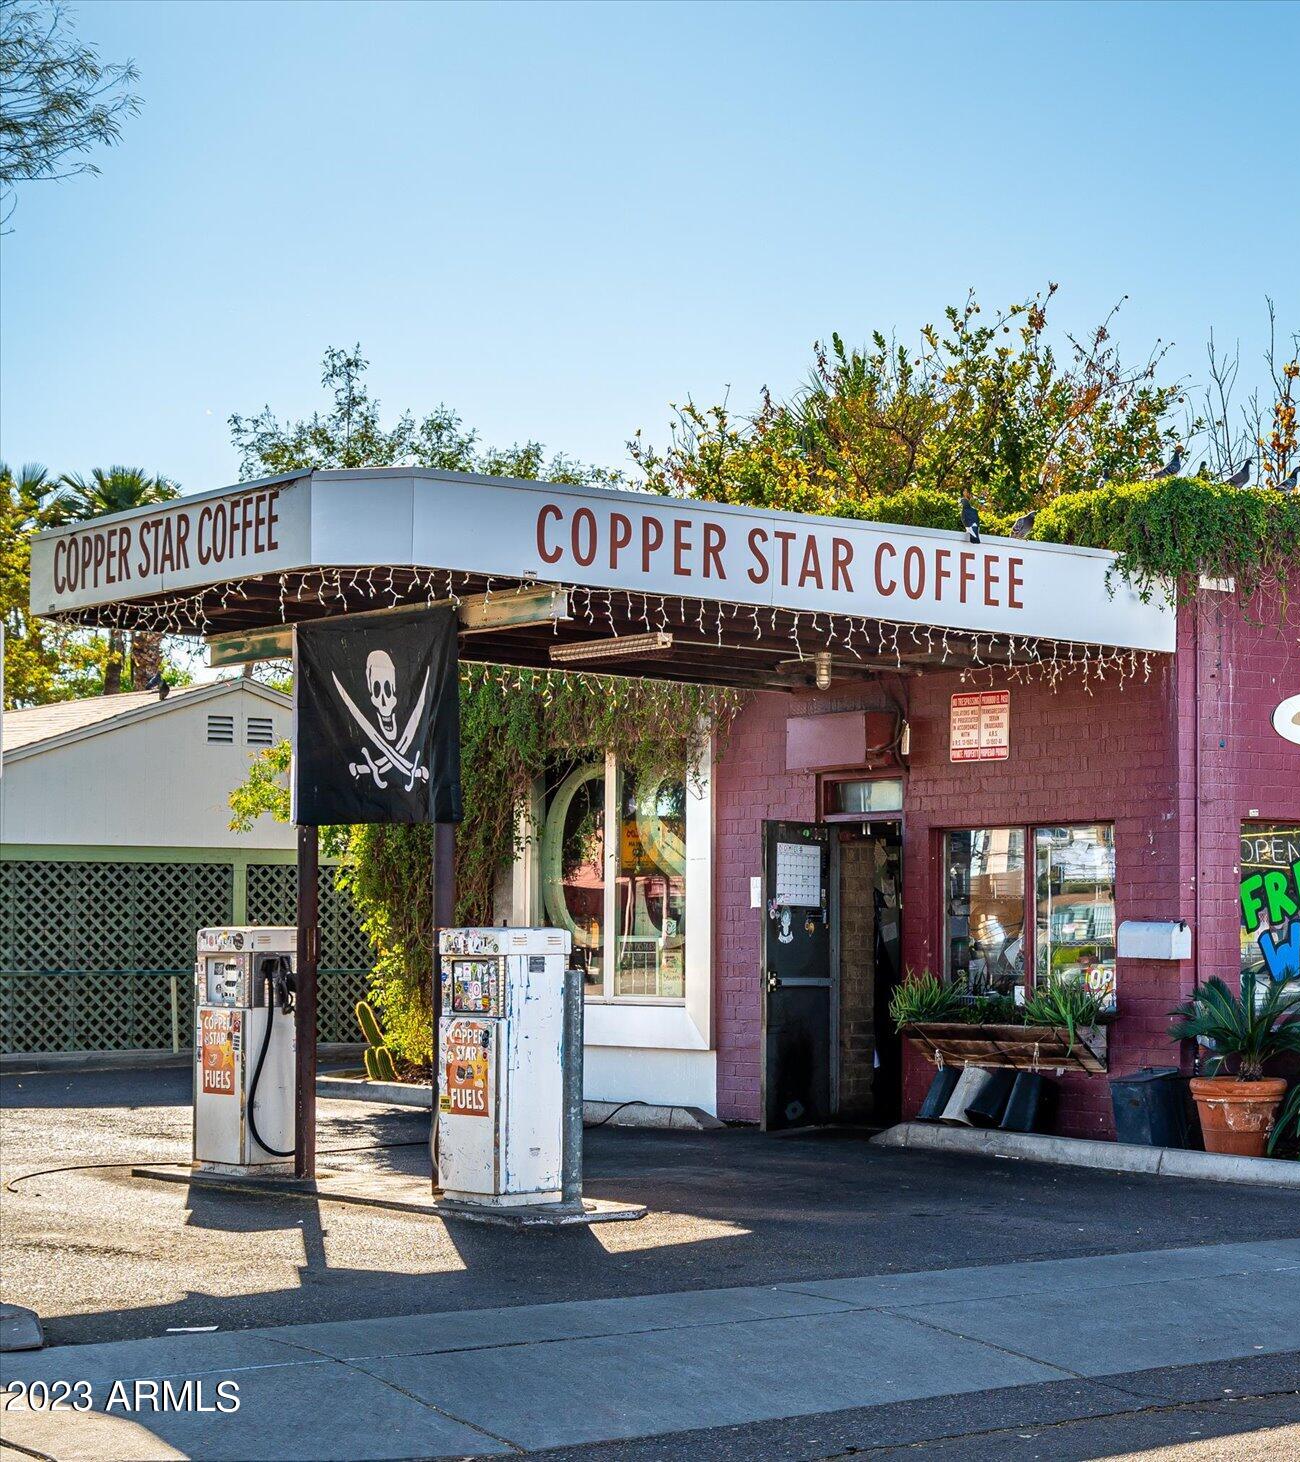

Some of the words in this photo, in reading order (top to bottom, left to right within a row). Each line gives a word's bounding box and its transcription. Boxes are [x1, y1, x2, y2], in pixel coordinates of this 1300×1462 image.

[54, 526, 132, 595] COPPER
[138, 513, 189, 578] STAR
[198, 491, 280, 566] COFFEE
[536, 503, 727, 580] COPPER
[746, 526, 855, 593] STAR
[874, 541, 1025, 610] COFFEE
[204, 1014, 233, 1031] COPPE
[209, 1031, 226, 1045] STAR
[450, 1028, 484, 1044] COPPER
[456, 1045, 477, 1061] STAR
[204, 1069, 231, 1090] FUELS
[450, 1088, 485, 1110] FUELS
